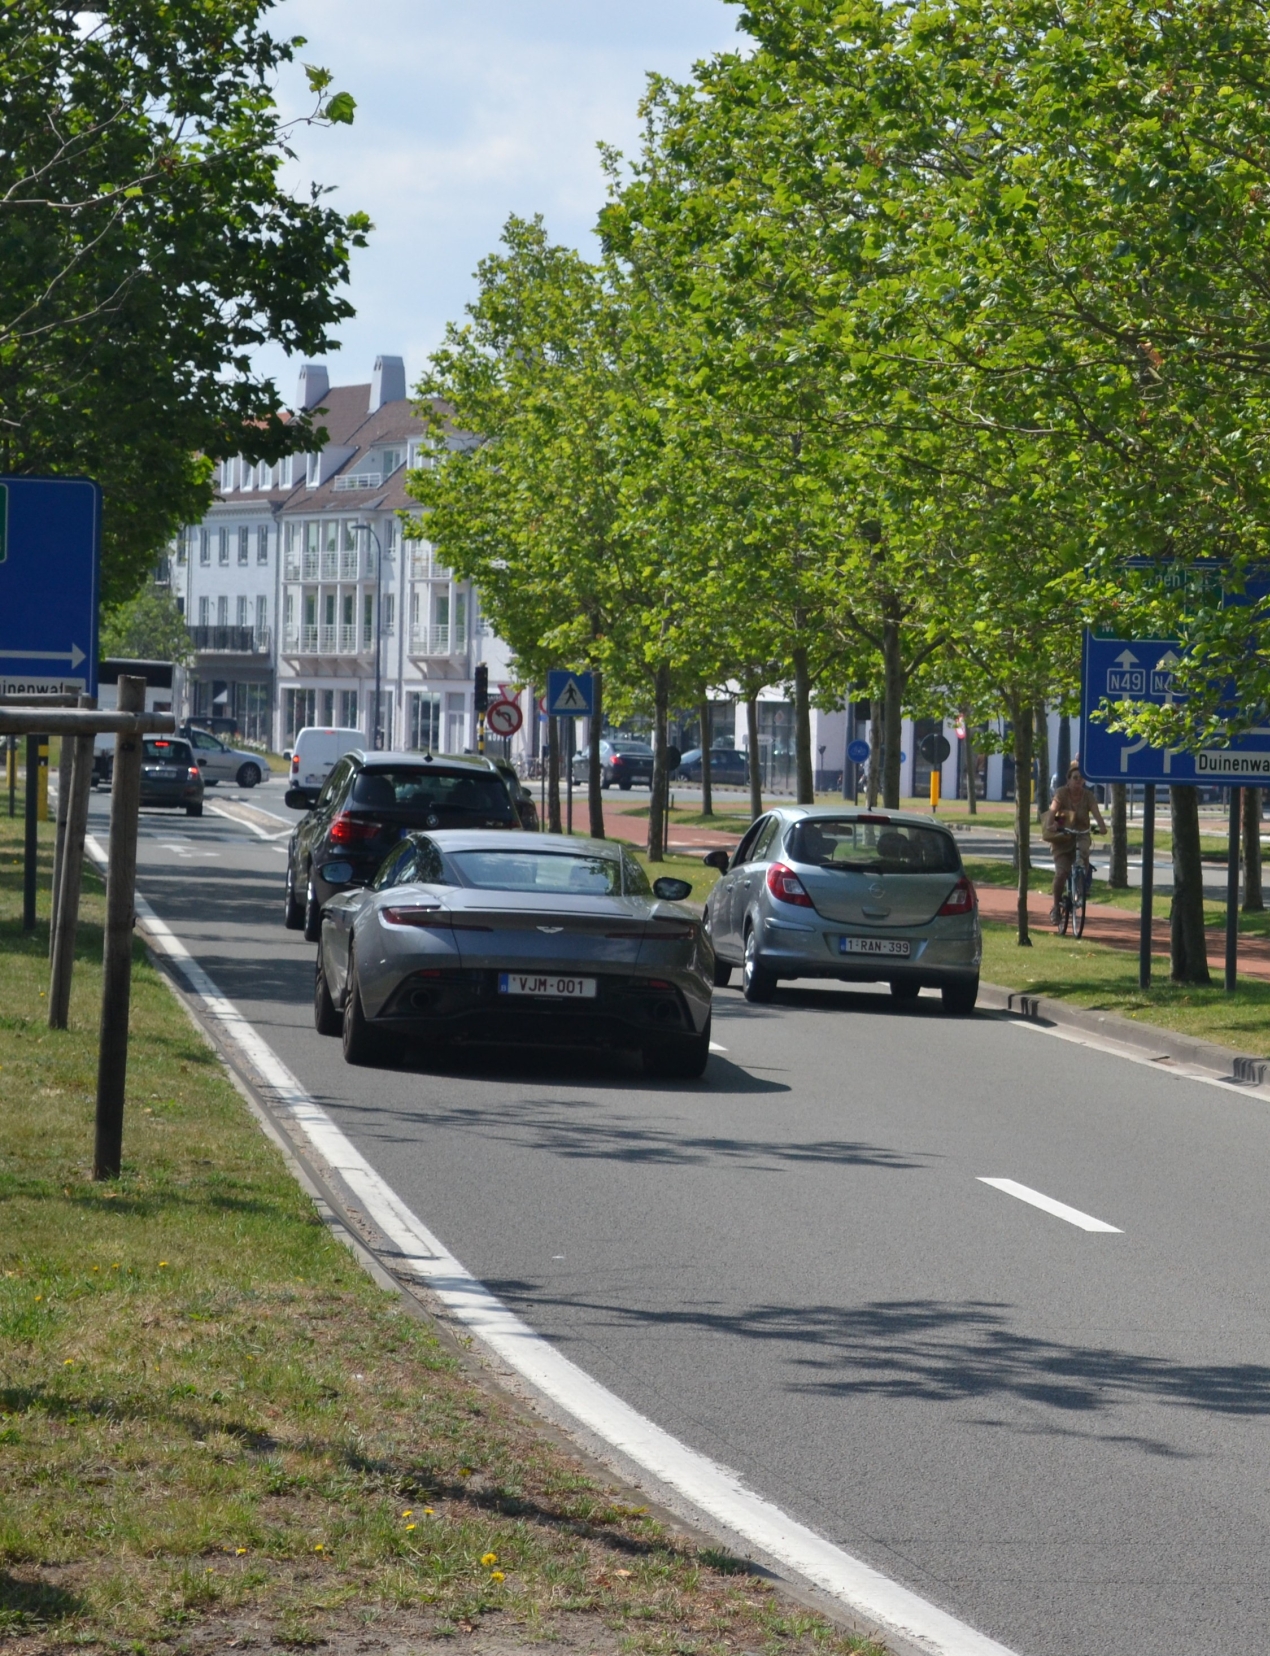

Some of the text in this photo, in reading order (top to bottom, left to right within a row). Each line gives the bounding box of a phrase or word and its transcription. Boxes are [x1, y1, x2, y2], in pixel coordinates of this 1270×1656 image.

[1110, 673, 1184, 691] N49 N4
[848, 940, 909, 953] 1-RAN-399
[519, 977, 583, 994] VJM-001
